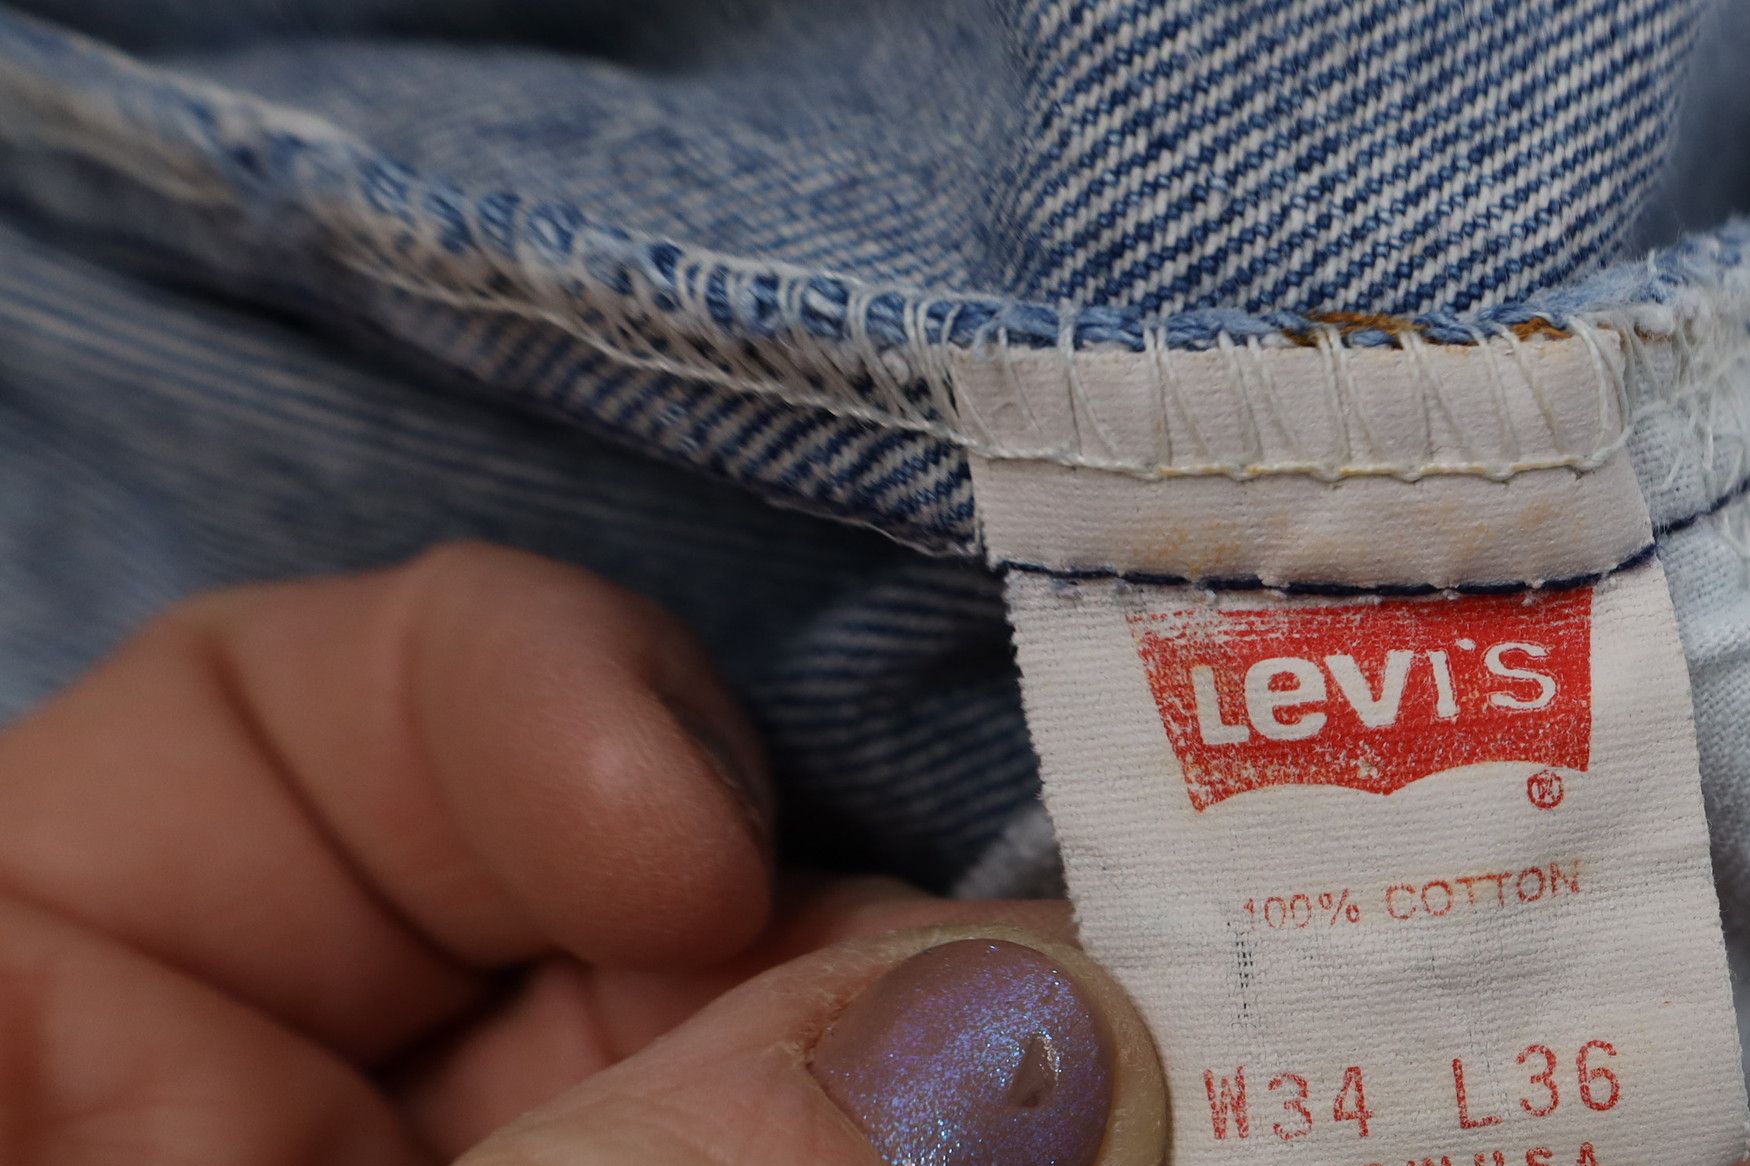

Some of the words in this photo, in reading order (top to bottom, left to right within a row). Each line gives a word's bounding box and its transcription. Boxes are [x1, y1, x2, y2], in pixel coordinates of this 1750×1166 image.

[1243, 888, 1361, 930] 100%
[1384, 860, 1582, 921] COTTON
[1203, 1064, 1373, 1141] W34
[1452, 1039, 1621, 1129] L36
